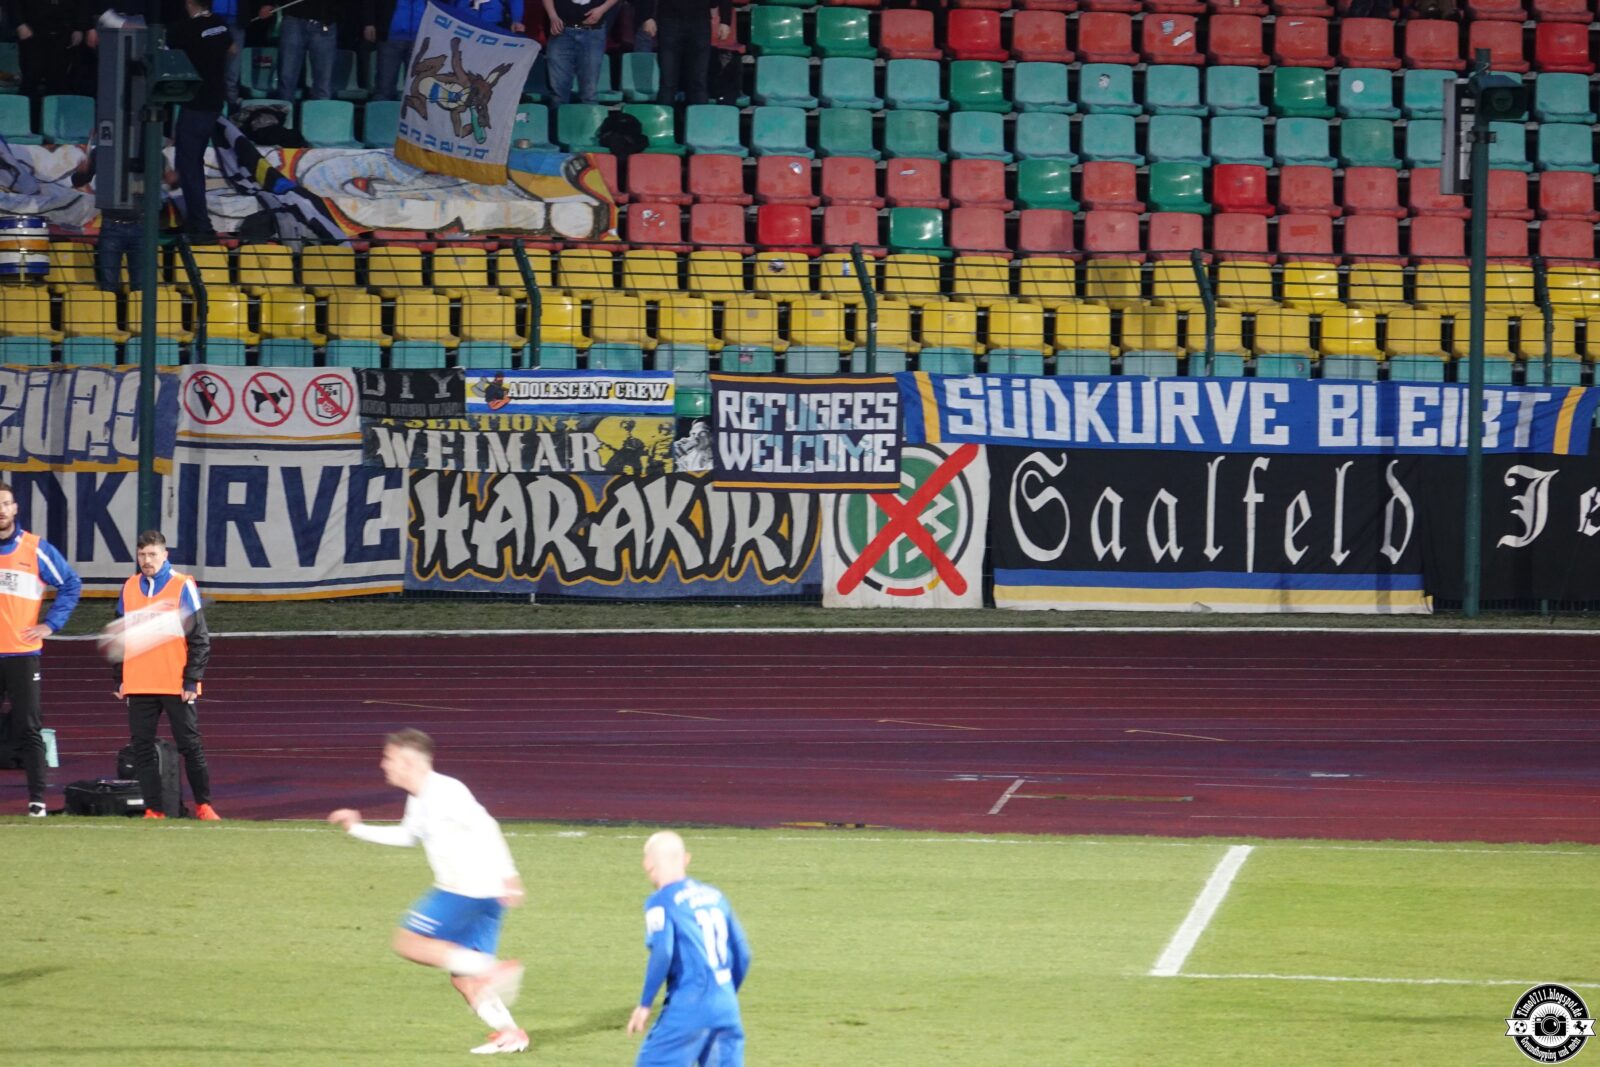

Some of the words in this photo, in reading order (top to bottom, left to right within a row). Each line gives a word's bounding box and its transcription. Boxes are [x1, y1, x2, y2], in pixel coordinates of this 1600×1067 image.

[507, 381, 612, 399] ADOLESCENT
[615, 382, 669, 400] CREW
[718, 390, 898, 431] REFUGEES
[944, 376, 1289, 444] SÜDKURVE
[1318, 384, 1552, 447] BLEIBT
[371, 427, 607, 473] WEIMAR
[718, 433, 896, 473] WELCOME
[414, 471, 809, 574] HARAKIRI
[1009, 451, 1414, 573] Saalfeld
